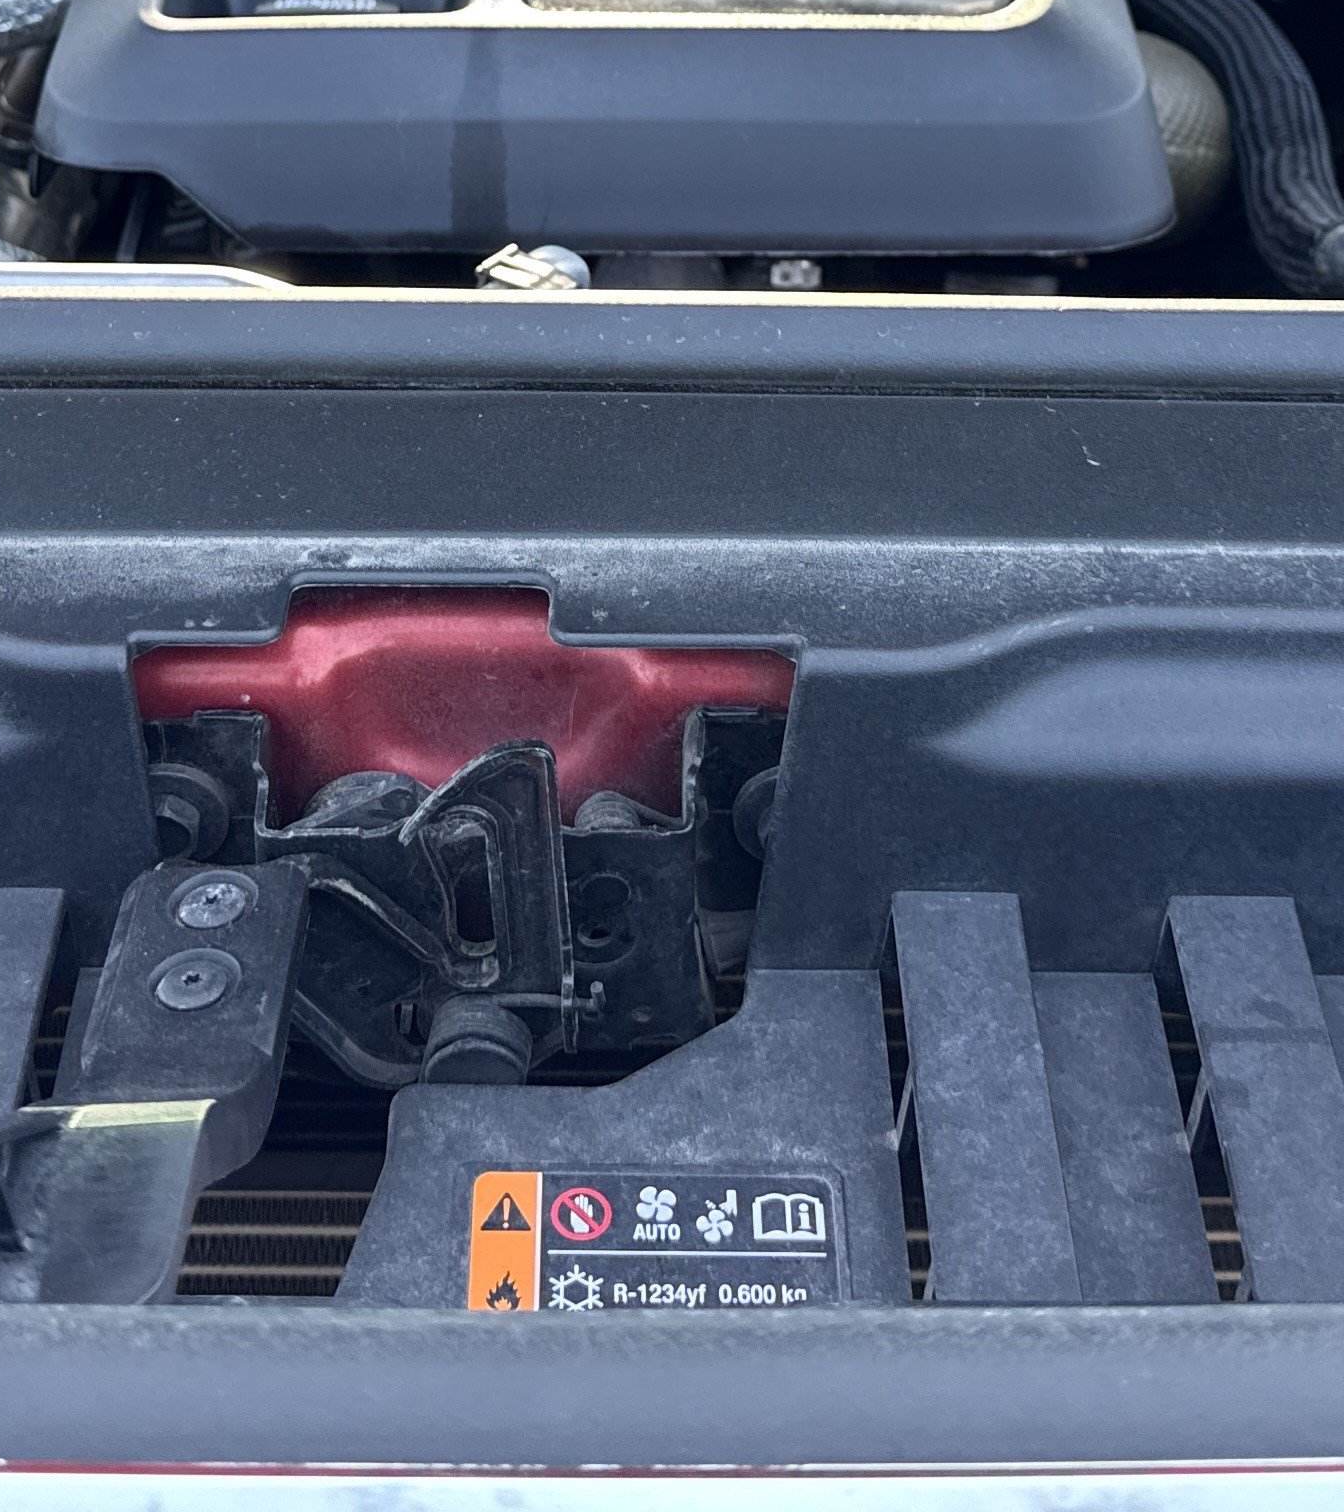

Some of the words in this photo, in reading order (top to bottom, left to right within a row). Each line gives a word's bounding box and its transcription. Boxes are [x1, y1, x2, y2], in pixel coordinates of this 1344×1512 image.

[632, 1223, 681, 1242] AUTO
[613, 1283, 707, 1308] R-1234yf
[718, 1284, 777, 1304] 0.600
